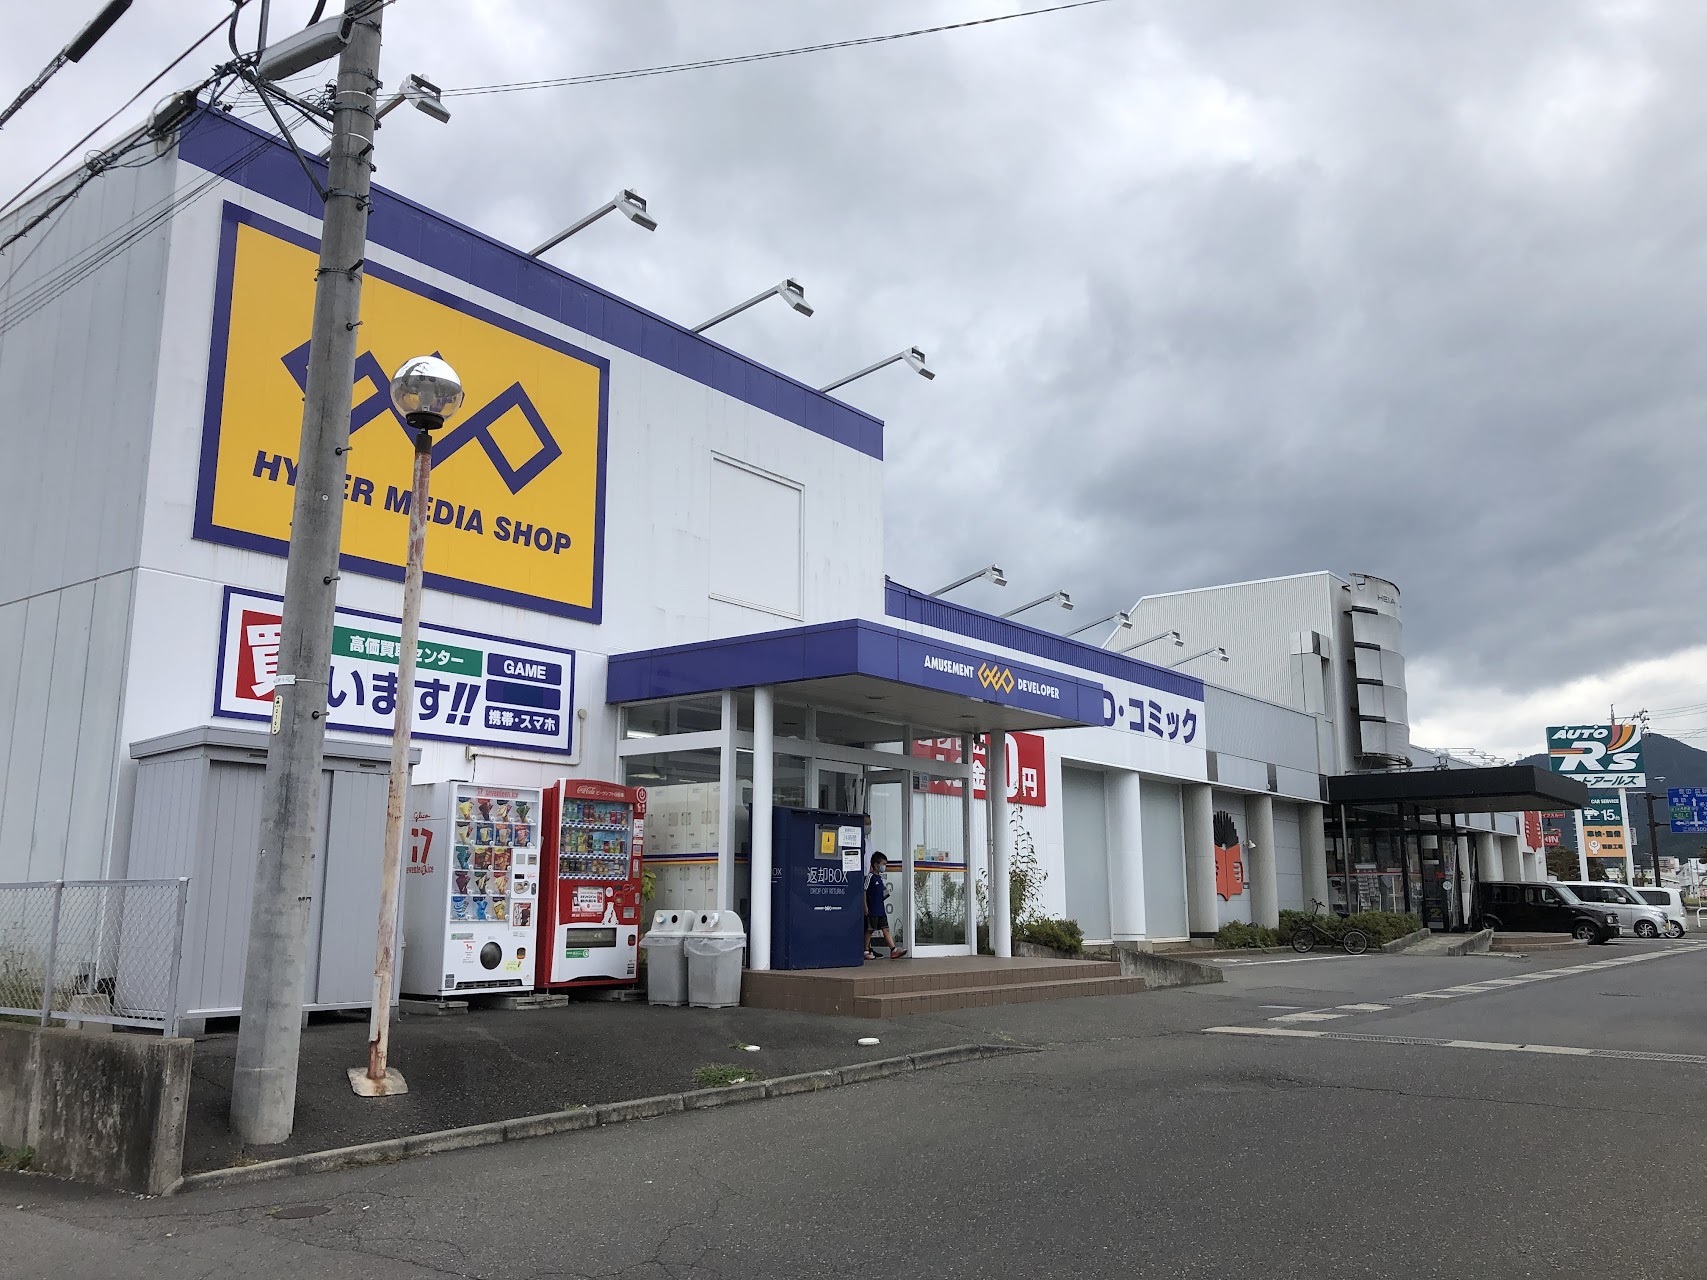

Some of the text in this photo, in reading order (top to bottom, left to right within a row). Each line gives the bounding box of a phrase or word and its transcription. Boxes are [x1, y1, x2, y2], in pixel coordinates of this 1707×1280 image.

[252, 449, 376, 506] HYR
[493, 515, 572, 556] SHOP
[503, 659, 547, 680] GAME
[924, 654, 974, 678] AMUSEMENT
[1017, 678, 1060, 700] DEVELOPER
[488, 709, 557, 733] 携帯・スマホ
[1551, 728, 1609, 740] AUTO
[485, 789, 510, 799] seventeen
[807, 866, 849, 883] 返却BOX
[810, 887, 822, 895] DROP
[829, 887, 846, 895] RETURNS
